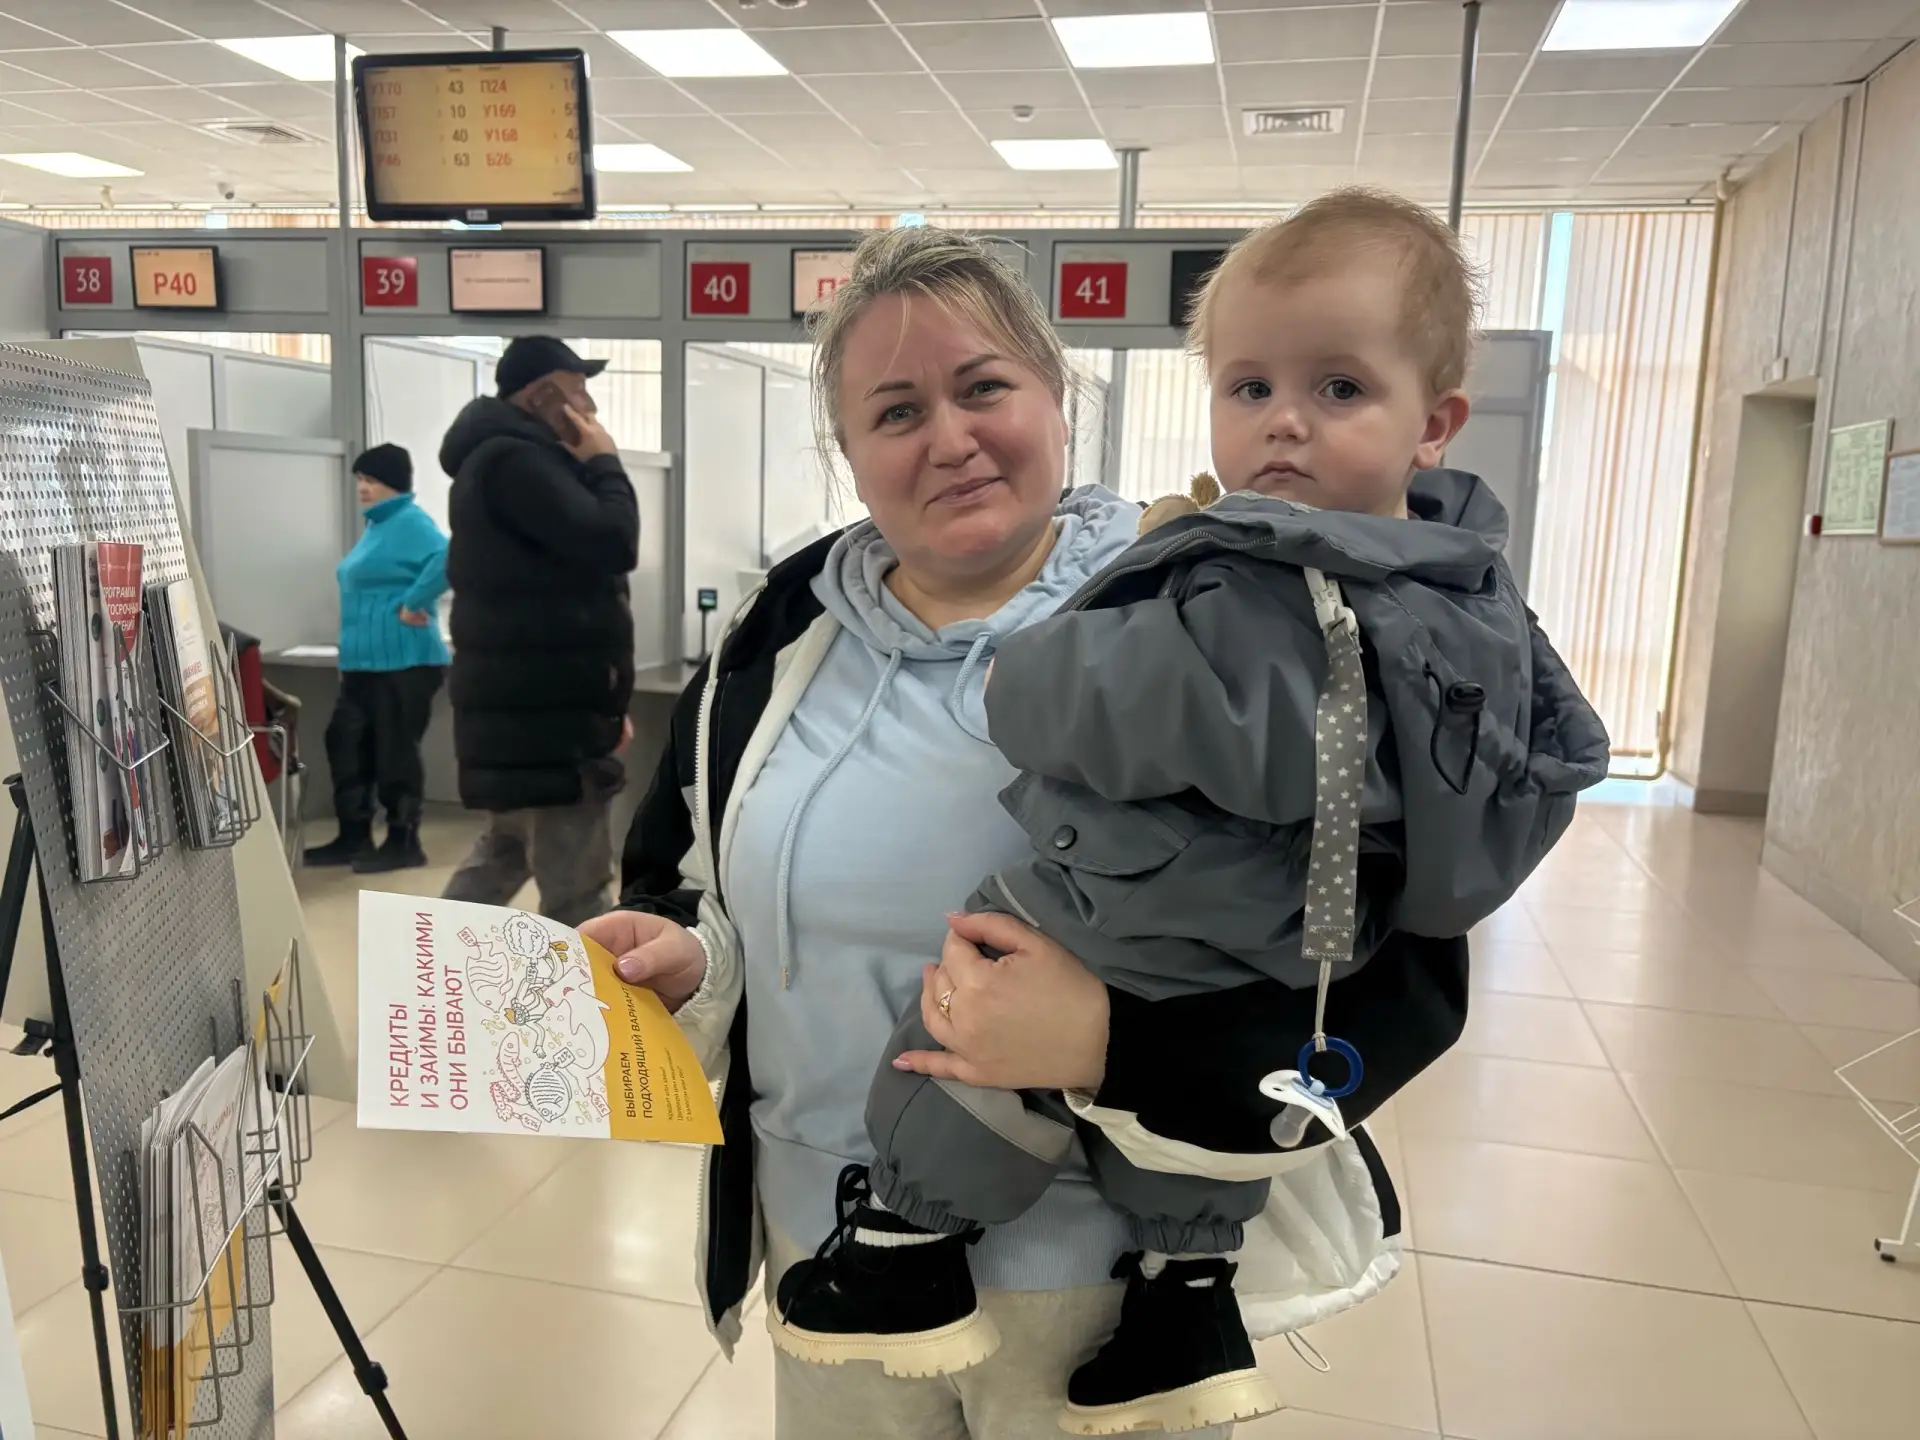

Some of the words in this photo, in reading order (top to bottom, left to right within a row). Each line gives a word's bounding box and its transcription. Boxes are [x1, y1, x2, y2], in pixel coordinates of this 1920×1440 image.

[448, 79, 464, 95] 43
[480, 78, 507, 94] П24
[450, 103, 466, 119] 10
[483, 103, 516, 118] У169
[452, 128, 469, 143] 40
[454, 152, 470, 167] 63
[76, 267, 101, 292] 38
[376, 268, 406, 295] 39
[704, 274, 737, 303] 40
[1075, 275, 1111, 305] 41
[415, 911, 436, 998] КАКИМИ
[444, 964, 466, 1055] БЫВАЮТ
[389, 1003, 413, 1107] КРЕДИТЫ
[414, 1004, 439, 1086] ЗАЙМЫ:
[449, 1062, 469, 1111] ОНИ
[619, 1052, 637, 1118] ВЫБИРАЕМ
[631, 1034, 653, 1119] ПОДХОДЯЩИЙ
[420, 1093, 440, 1109] И
